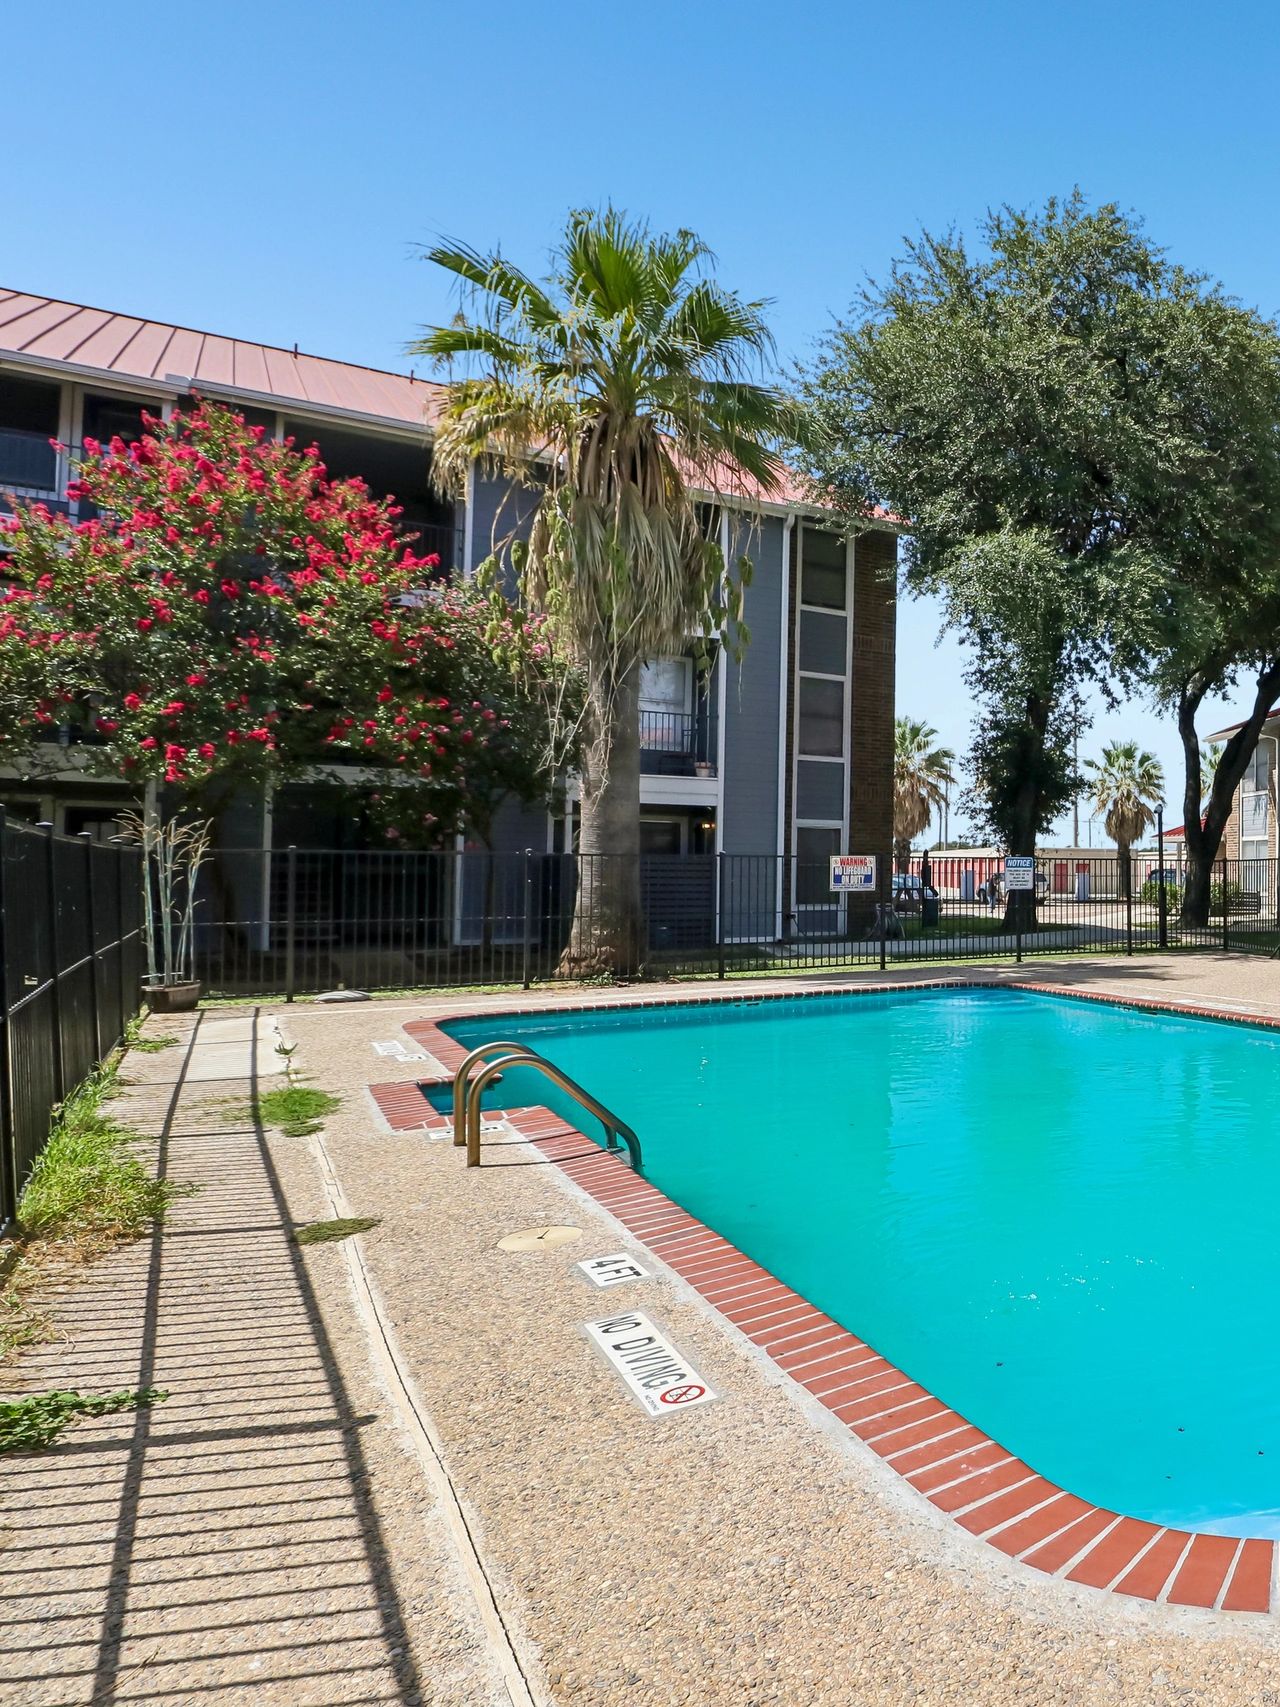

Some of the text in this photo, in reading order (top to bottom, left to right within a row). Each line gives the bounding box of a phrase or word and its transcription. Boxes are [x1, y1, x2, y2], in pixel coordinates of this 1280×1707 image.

[840, 857, 868, 866] WARNING
[1007, 859, 1031, 867] NOTICE
[835, 866, 871, 875] NO LIFEGUARD
[841, 875, 865, 884] ON DUTY
[590, 1259, 643, 1282] 4 FT
[595, 1315, 687, 1389] NO DIVING
